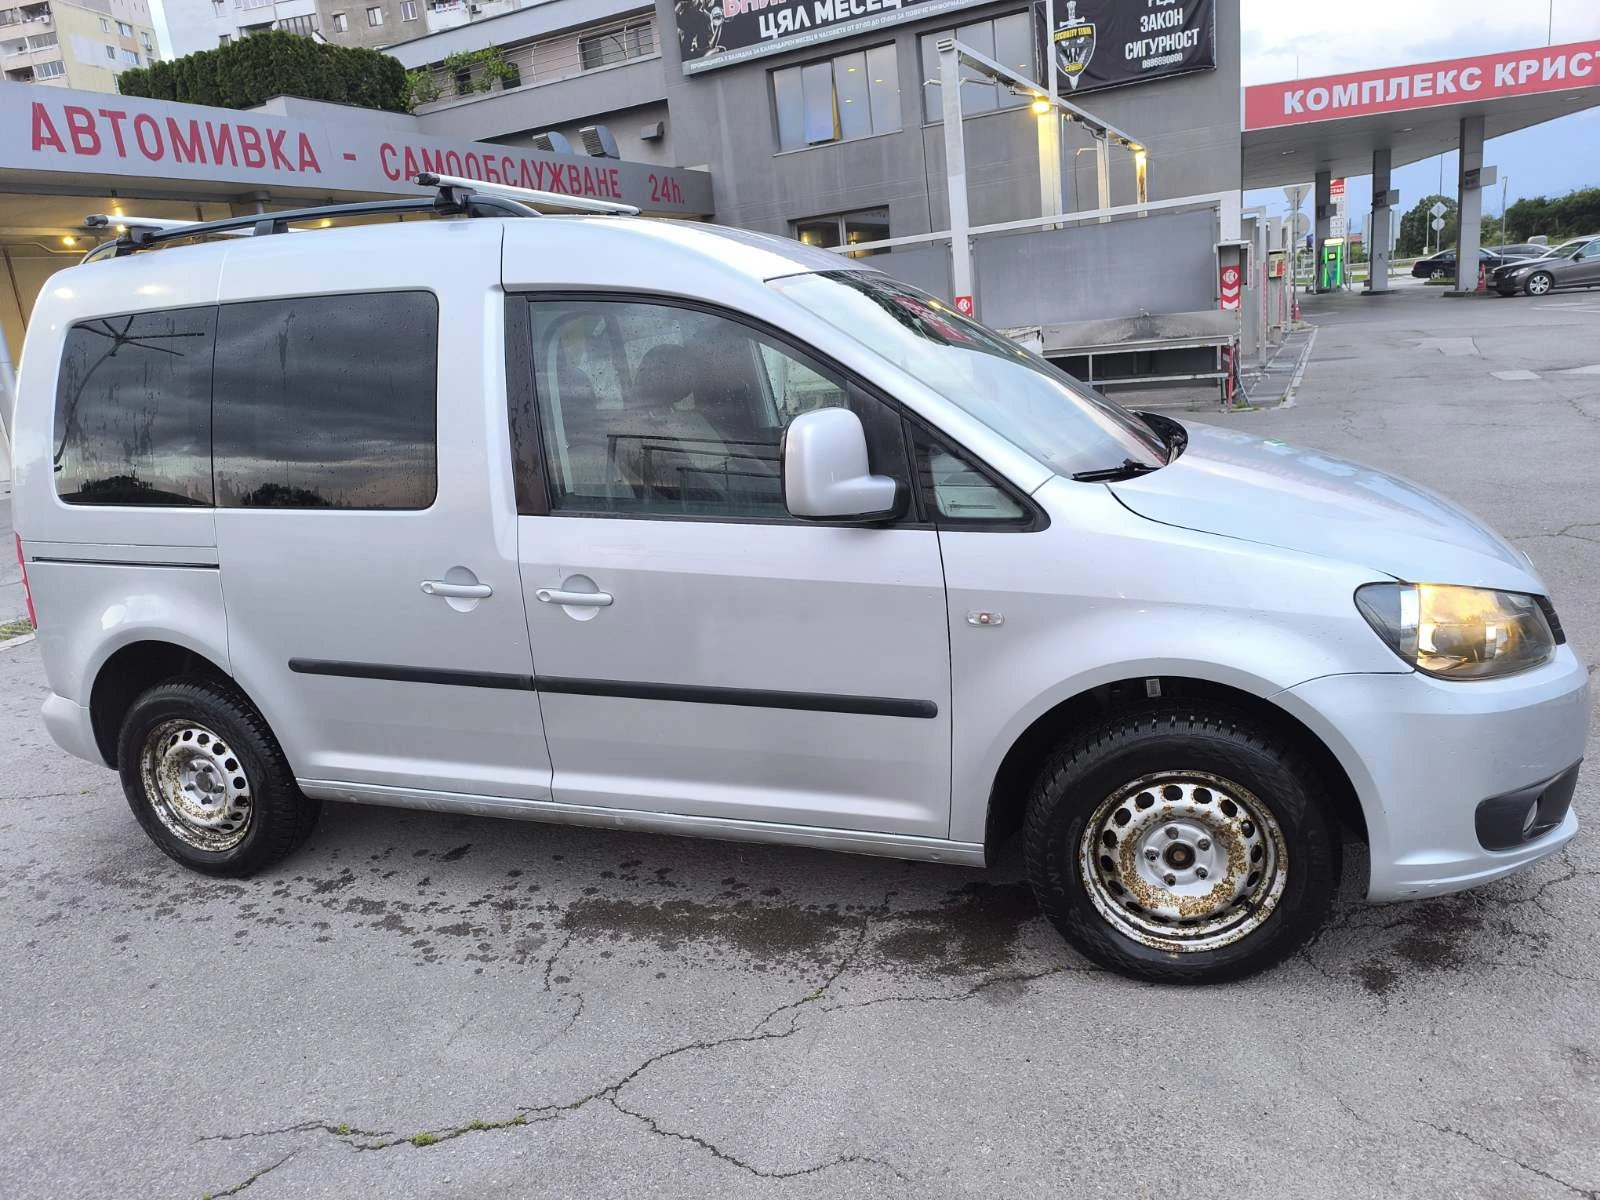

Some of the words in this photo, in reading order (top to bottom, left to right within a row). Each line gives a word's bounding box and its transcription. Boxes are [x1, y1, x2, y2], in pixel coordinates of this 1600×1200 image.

[758, 5, 811, 40] ЦЯЛ
[1140, 7, 1184, 33] ЗАКОН
[1125, 27, 1200, 60] СИГУРНОСТ
[1283, 66, 1483, 115] КОМПЛЕКС
[1494, 51, 1600, 88] КРИС
[31, 101, 322, 175] АВТОМИВКА
